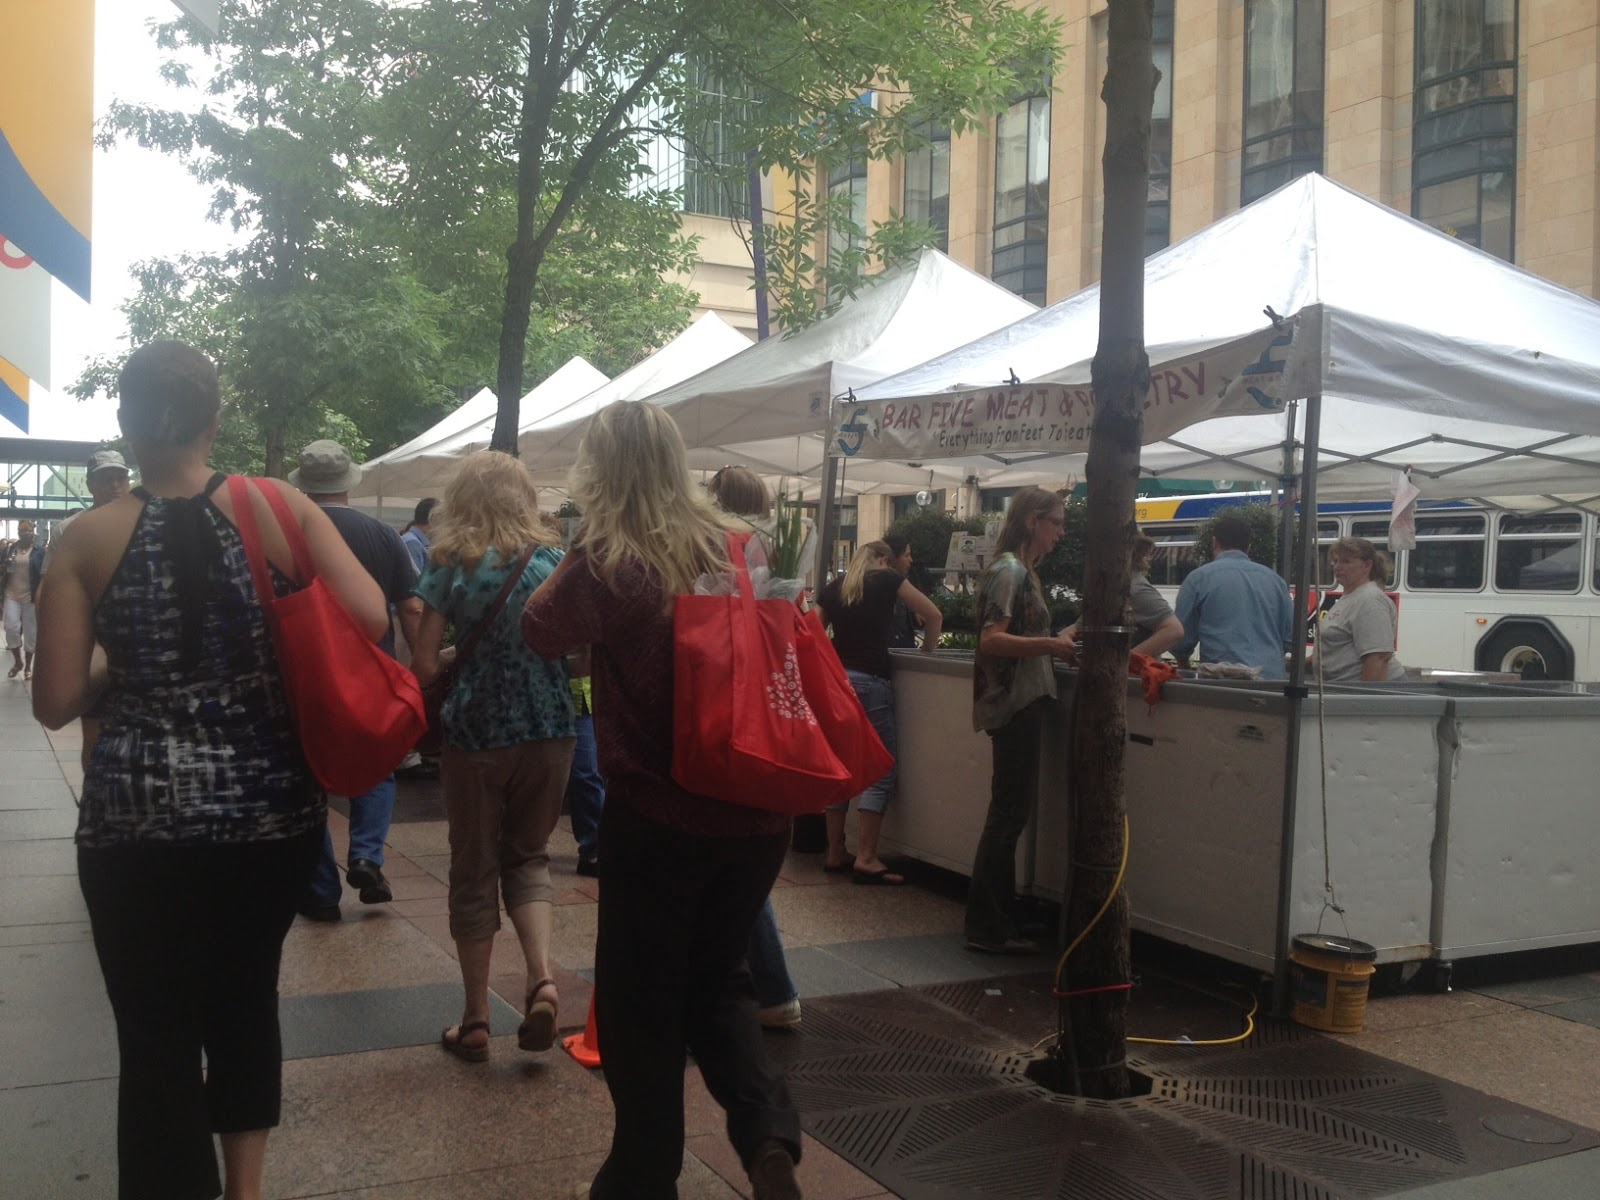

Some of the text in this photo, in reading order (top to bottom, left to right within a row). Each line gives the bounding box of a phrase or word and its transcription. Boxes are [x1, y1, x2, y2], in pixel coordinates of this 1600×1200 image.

[882, 361, 1205, 429] BAR FIVE MEAT & PTRY
